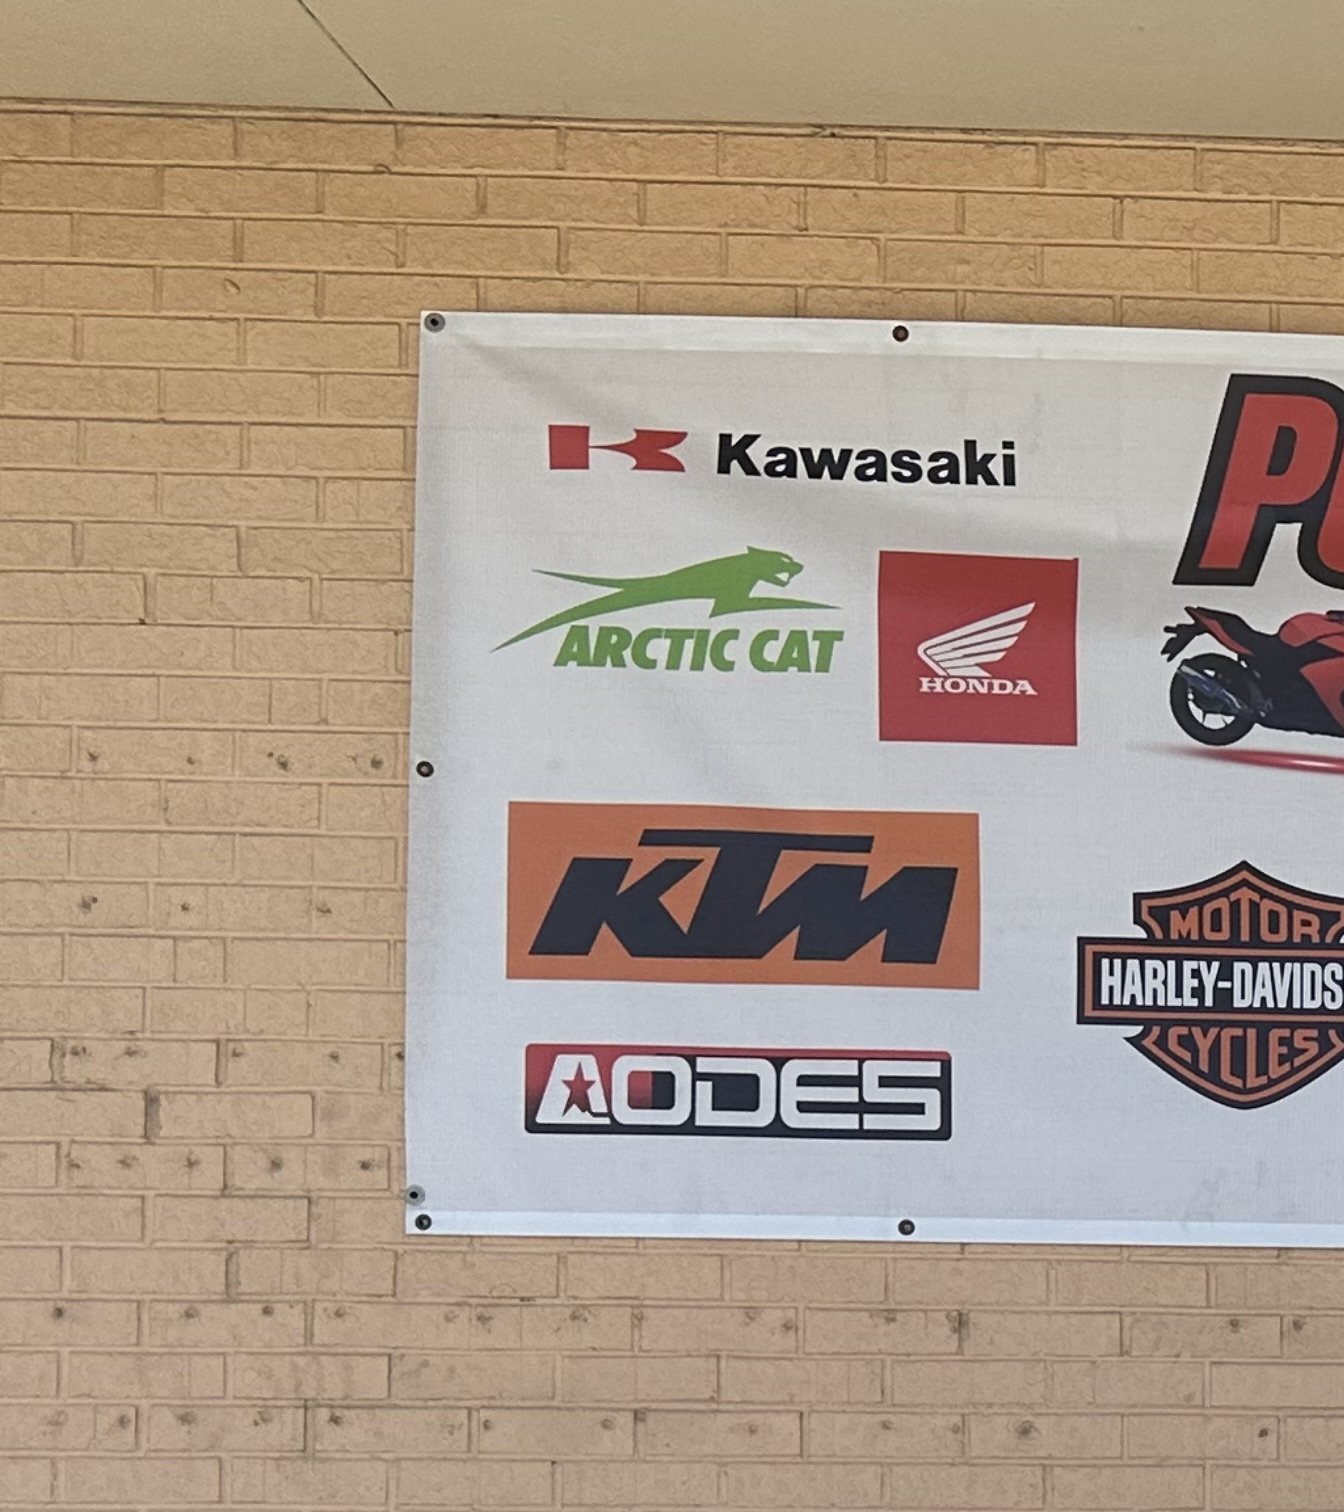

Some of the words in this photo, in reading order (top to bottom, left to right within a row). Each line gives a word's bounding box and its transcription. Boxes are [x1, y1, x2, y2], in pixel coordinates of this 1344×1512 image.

[716, 432, 1017, 487] Kawasaki
[552, 624, 734, 672] ARCTIC
[749, 628, 844, 673] CAT
[918, 676, 1038, 696] HONDA
[527, 828, 959, 965] KTM
[1169, 885, 1322, 944] MOTOR
[1165, 1025, 1320, 1090] CYCLES
[534, 1052, 943, 1132] AODES
